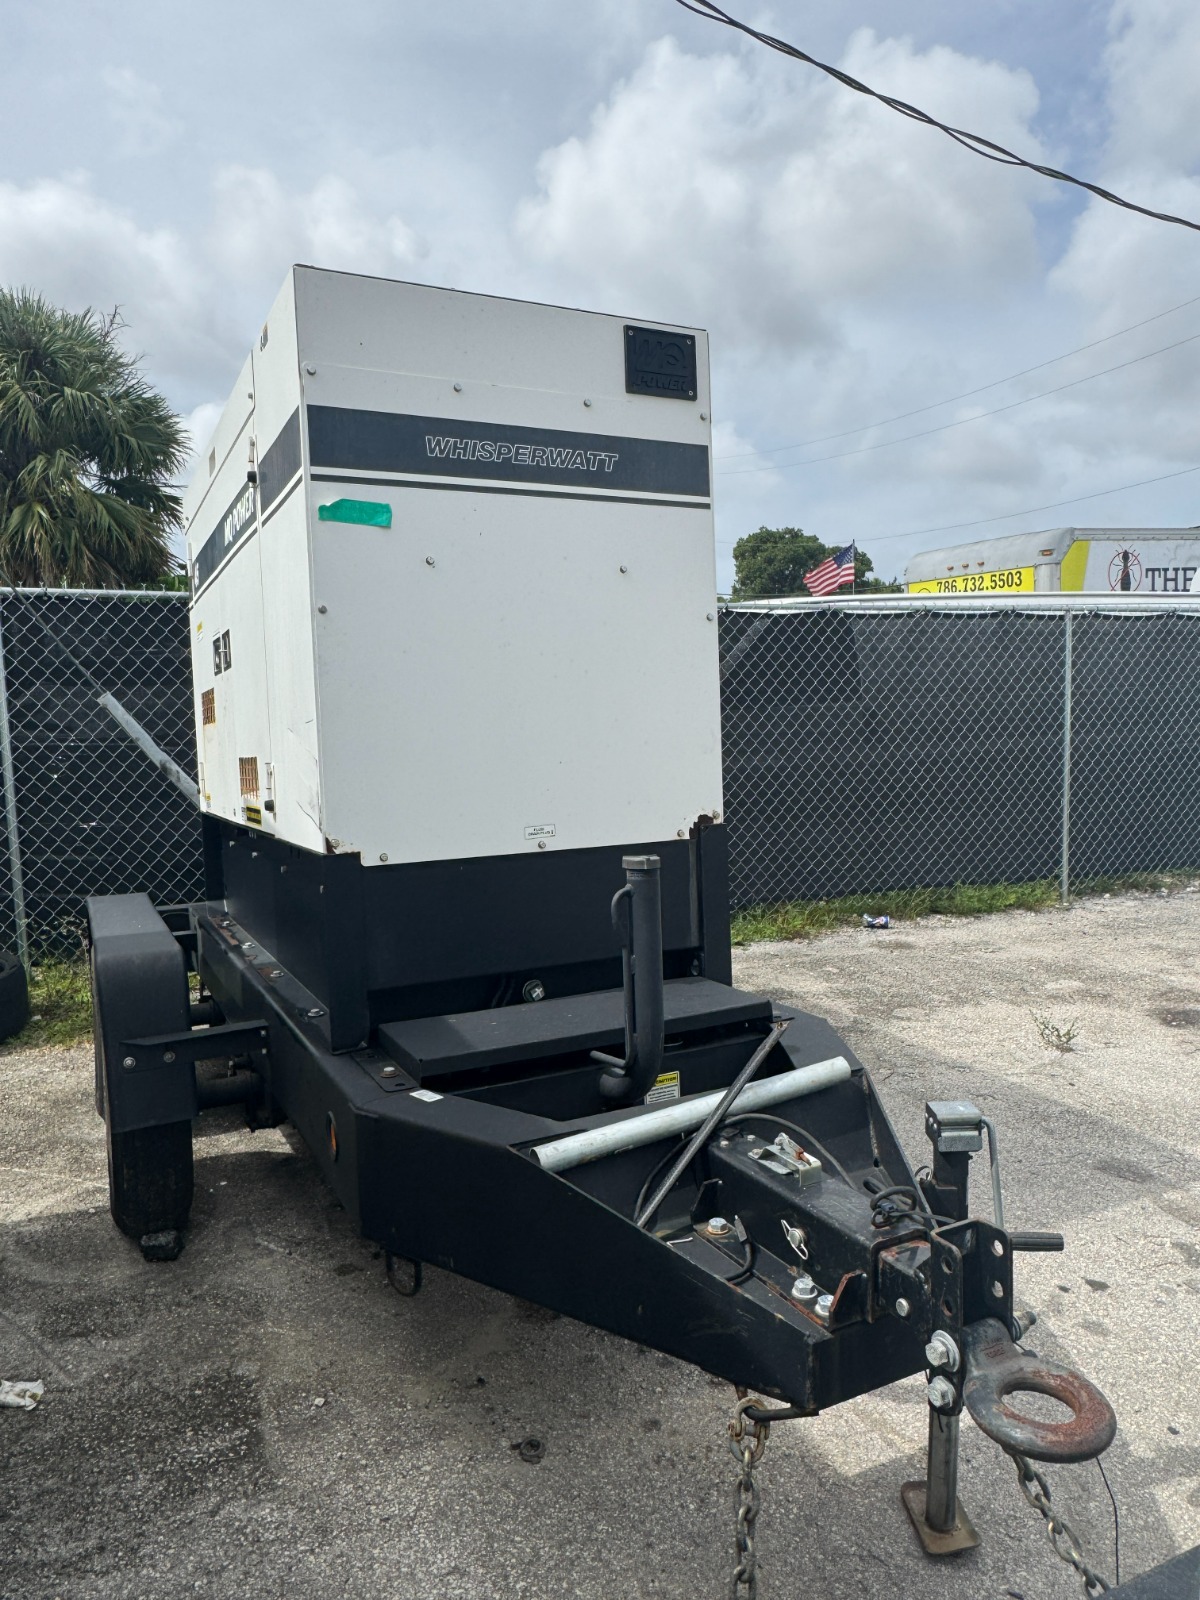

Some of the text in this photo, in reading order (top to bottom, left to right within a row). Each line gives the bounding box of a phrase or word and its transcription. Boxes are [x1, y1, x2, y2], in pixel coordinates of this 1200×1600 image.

[633, 374, 688, 392] POWER
[425, 435, 619, 472] WHISPERWATT
[224, 487, 254, 547] MQ POWER
[936, 570, 1023, 593] 786.732.5503
[656, 1076, 676, 1084] CAUTION
